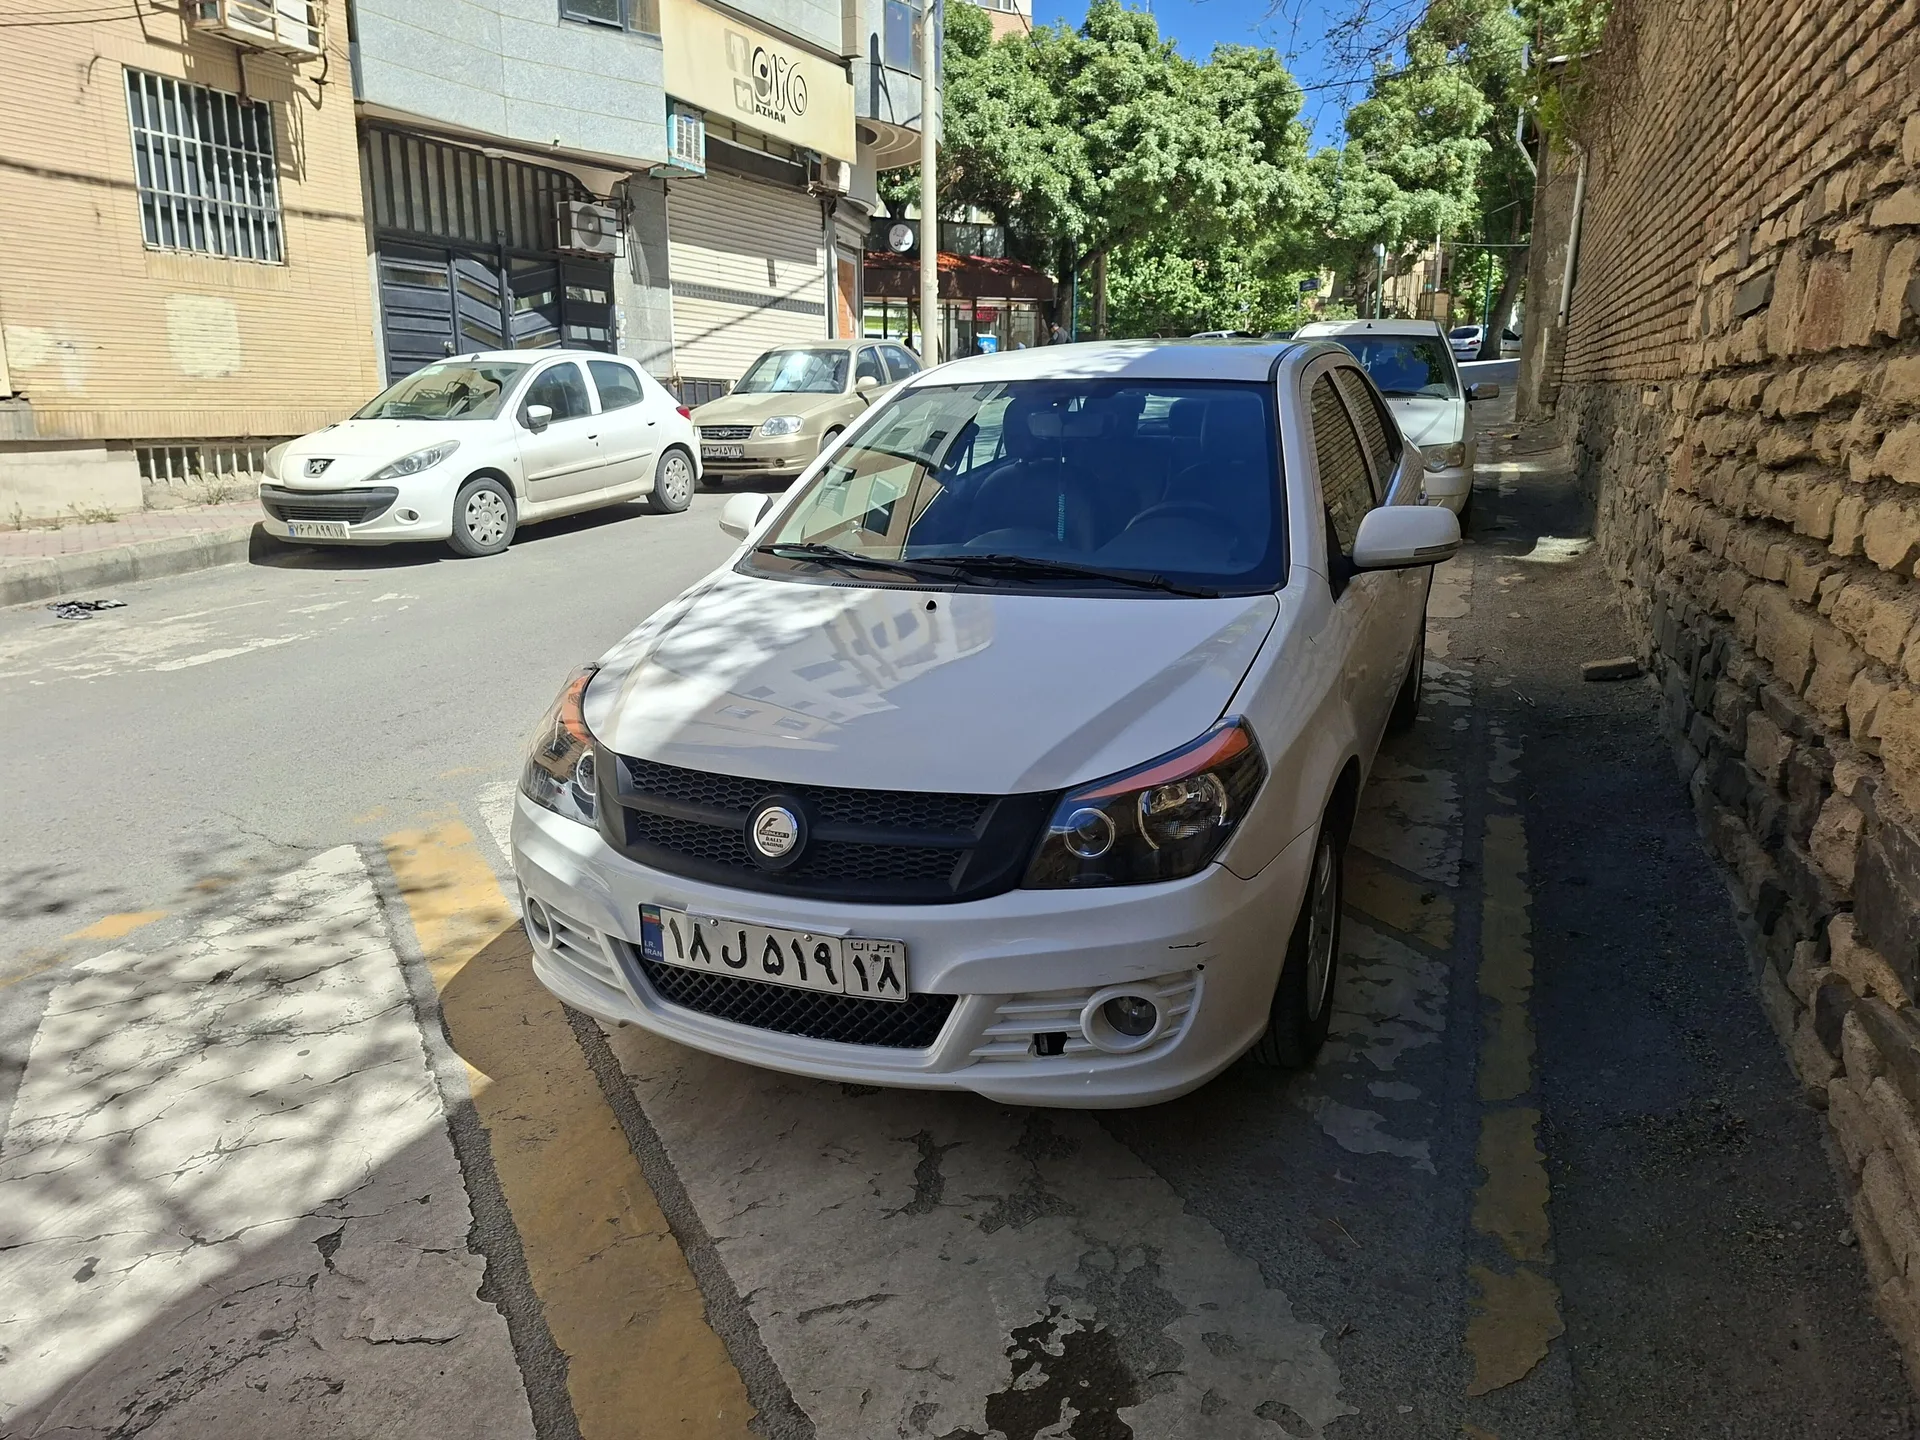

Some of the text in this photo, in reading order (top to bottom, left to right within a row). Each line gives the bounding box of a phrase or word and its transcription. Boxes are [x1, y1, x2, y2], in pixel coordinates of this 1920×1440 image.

[644, 948, 663, 957] IRAN
[669, 917, 838, 985] ۱۸ ل ۵۱۹
[850, 942, 895, 953] ایران
[852, 954, 901, 995] ۱۸
